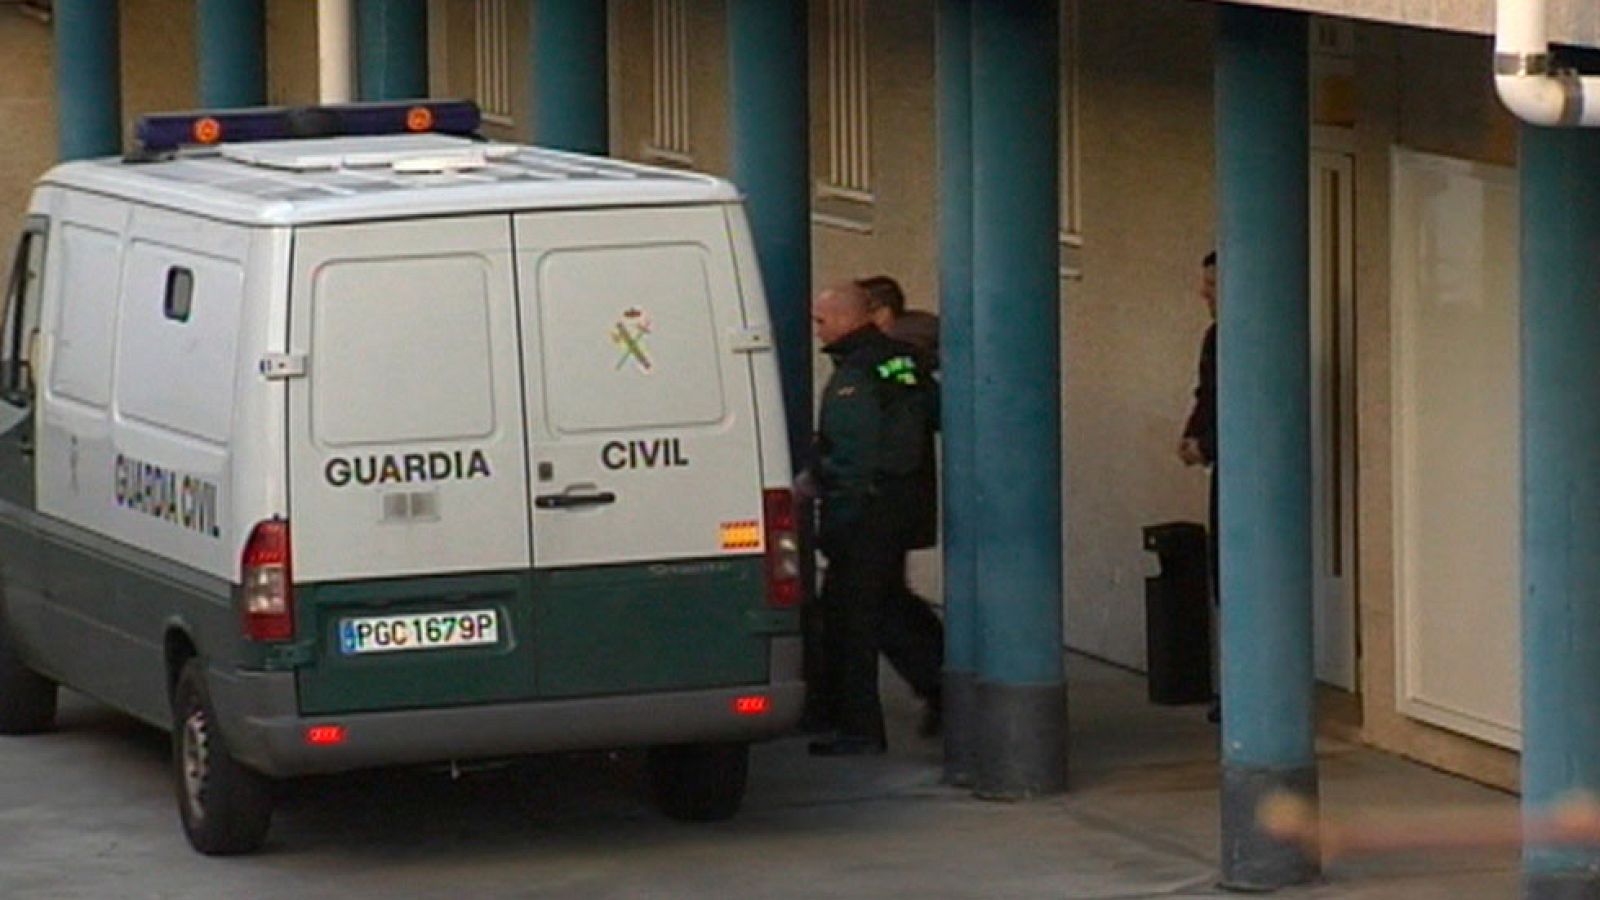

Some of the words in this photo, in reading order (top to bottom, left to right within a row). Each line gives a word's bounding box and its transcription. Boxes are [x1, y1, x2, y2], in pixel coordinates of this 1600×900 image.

[114, 453, 178, 523] GUARDIA
[182, 474, 220, 538] CIVIL
[325, 449, 490, 486] GUARDIA
[601, 439, 690, 469] CIVIL
